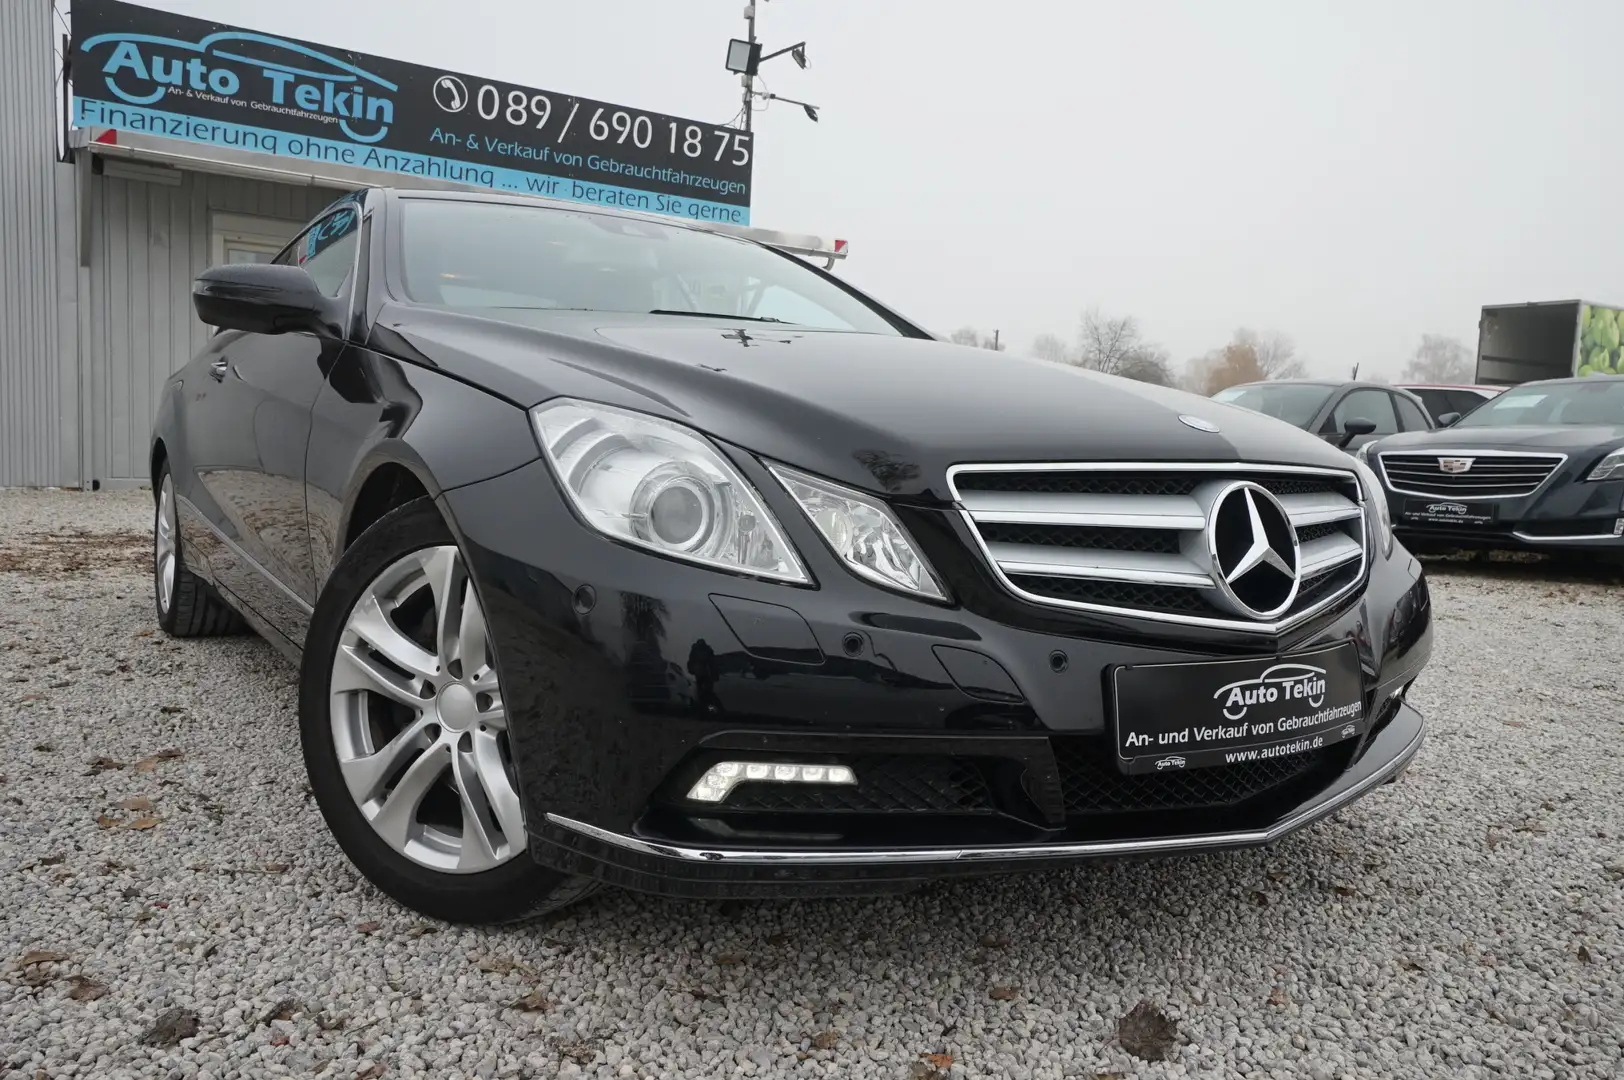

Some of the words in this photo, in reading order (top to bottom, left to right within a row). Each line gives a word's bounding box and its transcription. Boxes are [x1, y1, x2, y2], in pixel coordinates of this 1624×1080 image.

[102, 41, 240, 96] Auto
[262, 69, 394, 124] Tekin
[167, 86, 184, 97] An-
[186, 89, 194, 98] &
[195, 90, 229, 105] Verkauf
[230, 97, 247, 108] von
[250, 100, 339, 125] Gebrauchtfahrzeugen
[476, 83, 552, 130] 089
[588, 107, 653, 149] 690
[668, 120, 702, 158] 18
[712, 129, 751, 167] 75
[287, 137, 356, 164] ohne
[525, 175, 560, 195] wir
[572, 180, 649, 209] beraten
[655, 193, 682, 214] Sie
[429, 127, 462, 145] An-
[466, 133, 480, 151] &
[484, 136, 550, 162] Verkauf
[553, 151, 583, 168] von
[587, 155, 746, 196] Gebrauchtfahrzeugen
[1225, 686, 1278, 707] Auto
[1282, 677, 1326, 700] Tekin
[1125, 731, 1154, 747] An-
[1158, 727, 1189, 745] und
[1193, 722, 1249, 742] Verkauf
[1251, 721, 1275, 736] von
[1277, 700, 1362, 732] Gebrauchtfahrzeugen
[1225, 735, 1324, 764] www.autotekin.de
